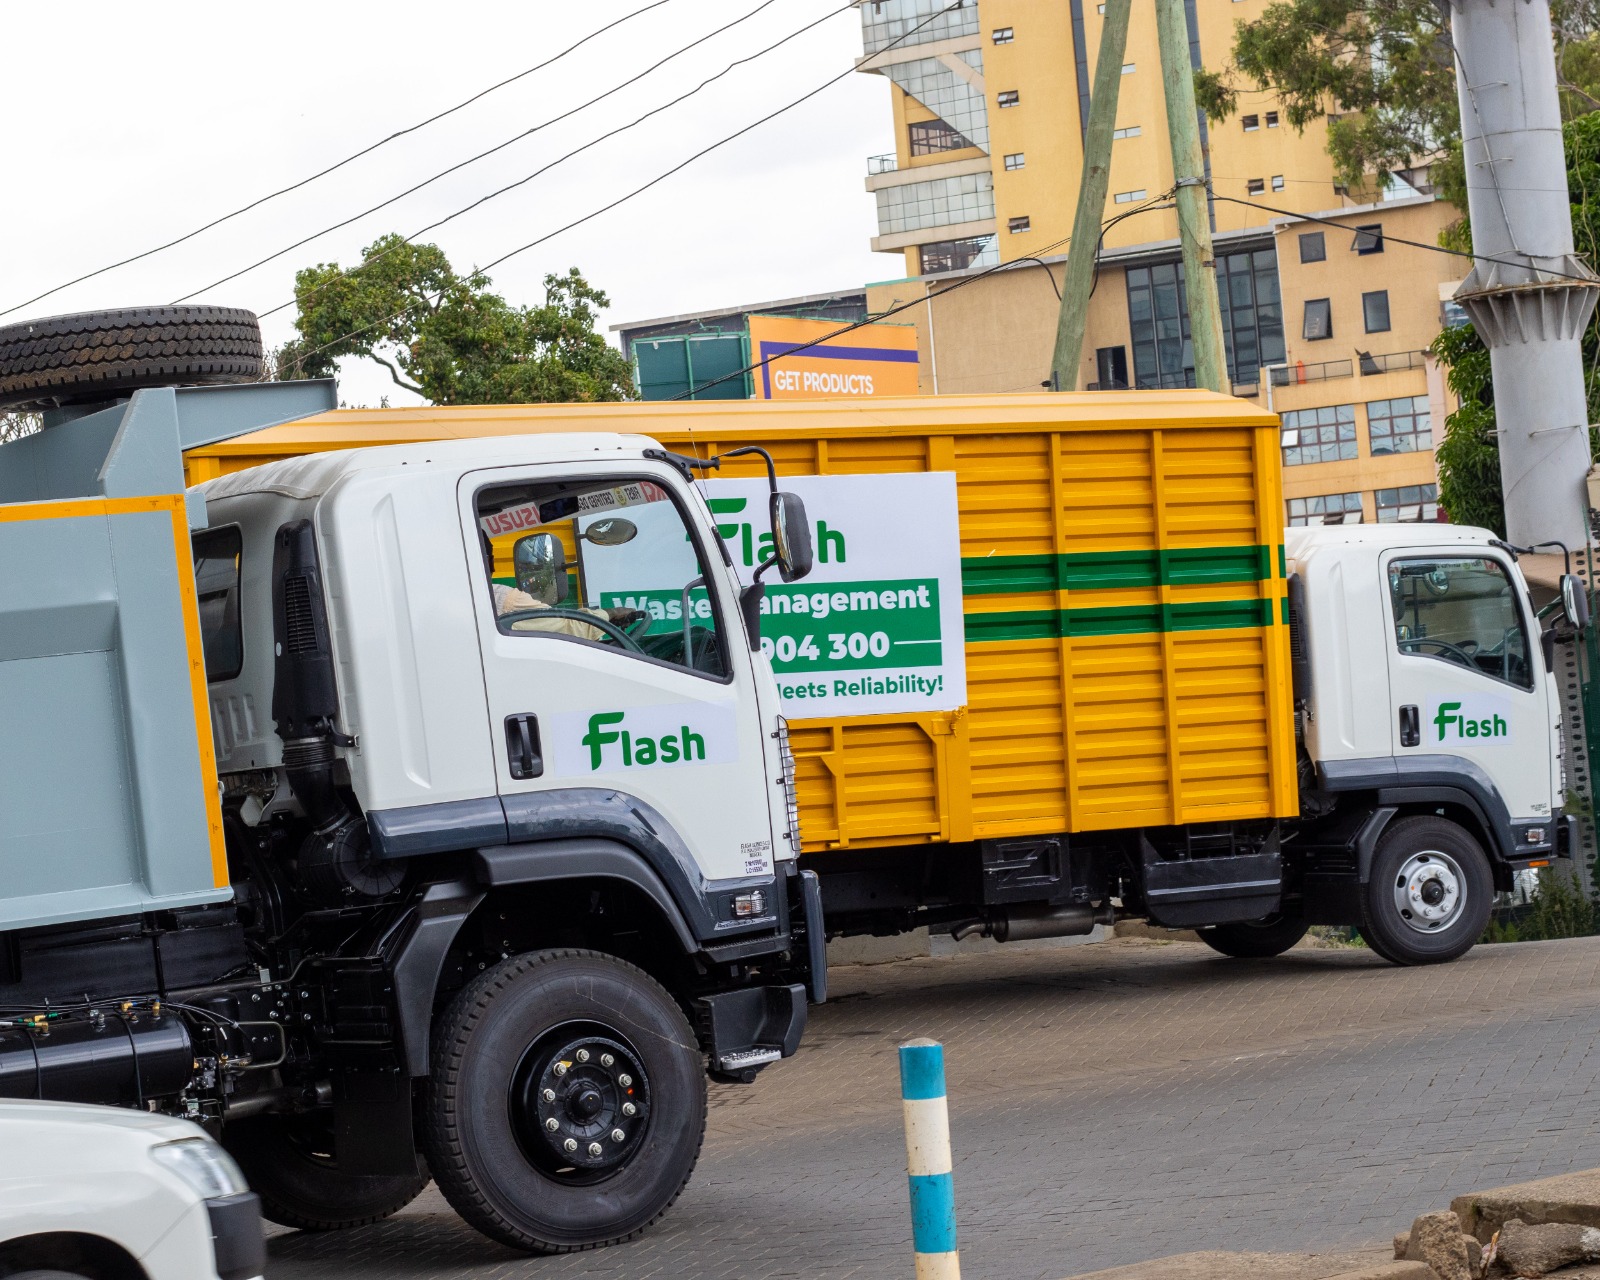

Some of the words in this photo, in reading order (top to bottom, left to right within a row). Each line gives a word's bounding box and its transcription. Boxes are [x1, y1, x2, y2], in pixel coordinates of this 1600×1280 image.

[774, 370, 801, 391] GET
[803, 372, 874, 395] PRODUCTS
[612, 595, 712, 621] Waste
[759, 584, 931, 618] anagement
[828, 631, 890, 660] 300
[777, 681, 827, 700] eets
[833, 674, 944, 697] Reliability!
[1433, 702, 1507, 741] Flash
[582, 711, 706, 770] Flash
